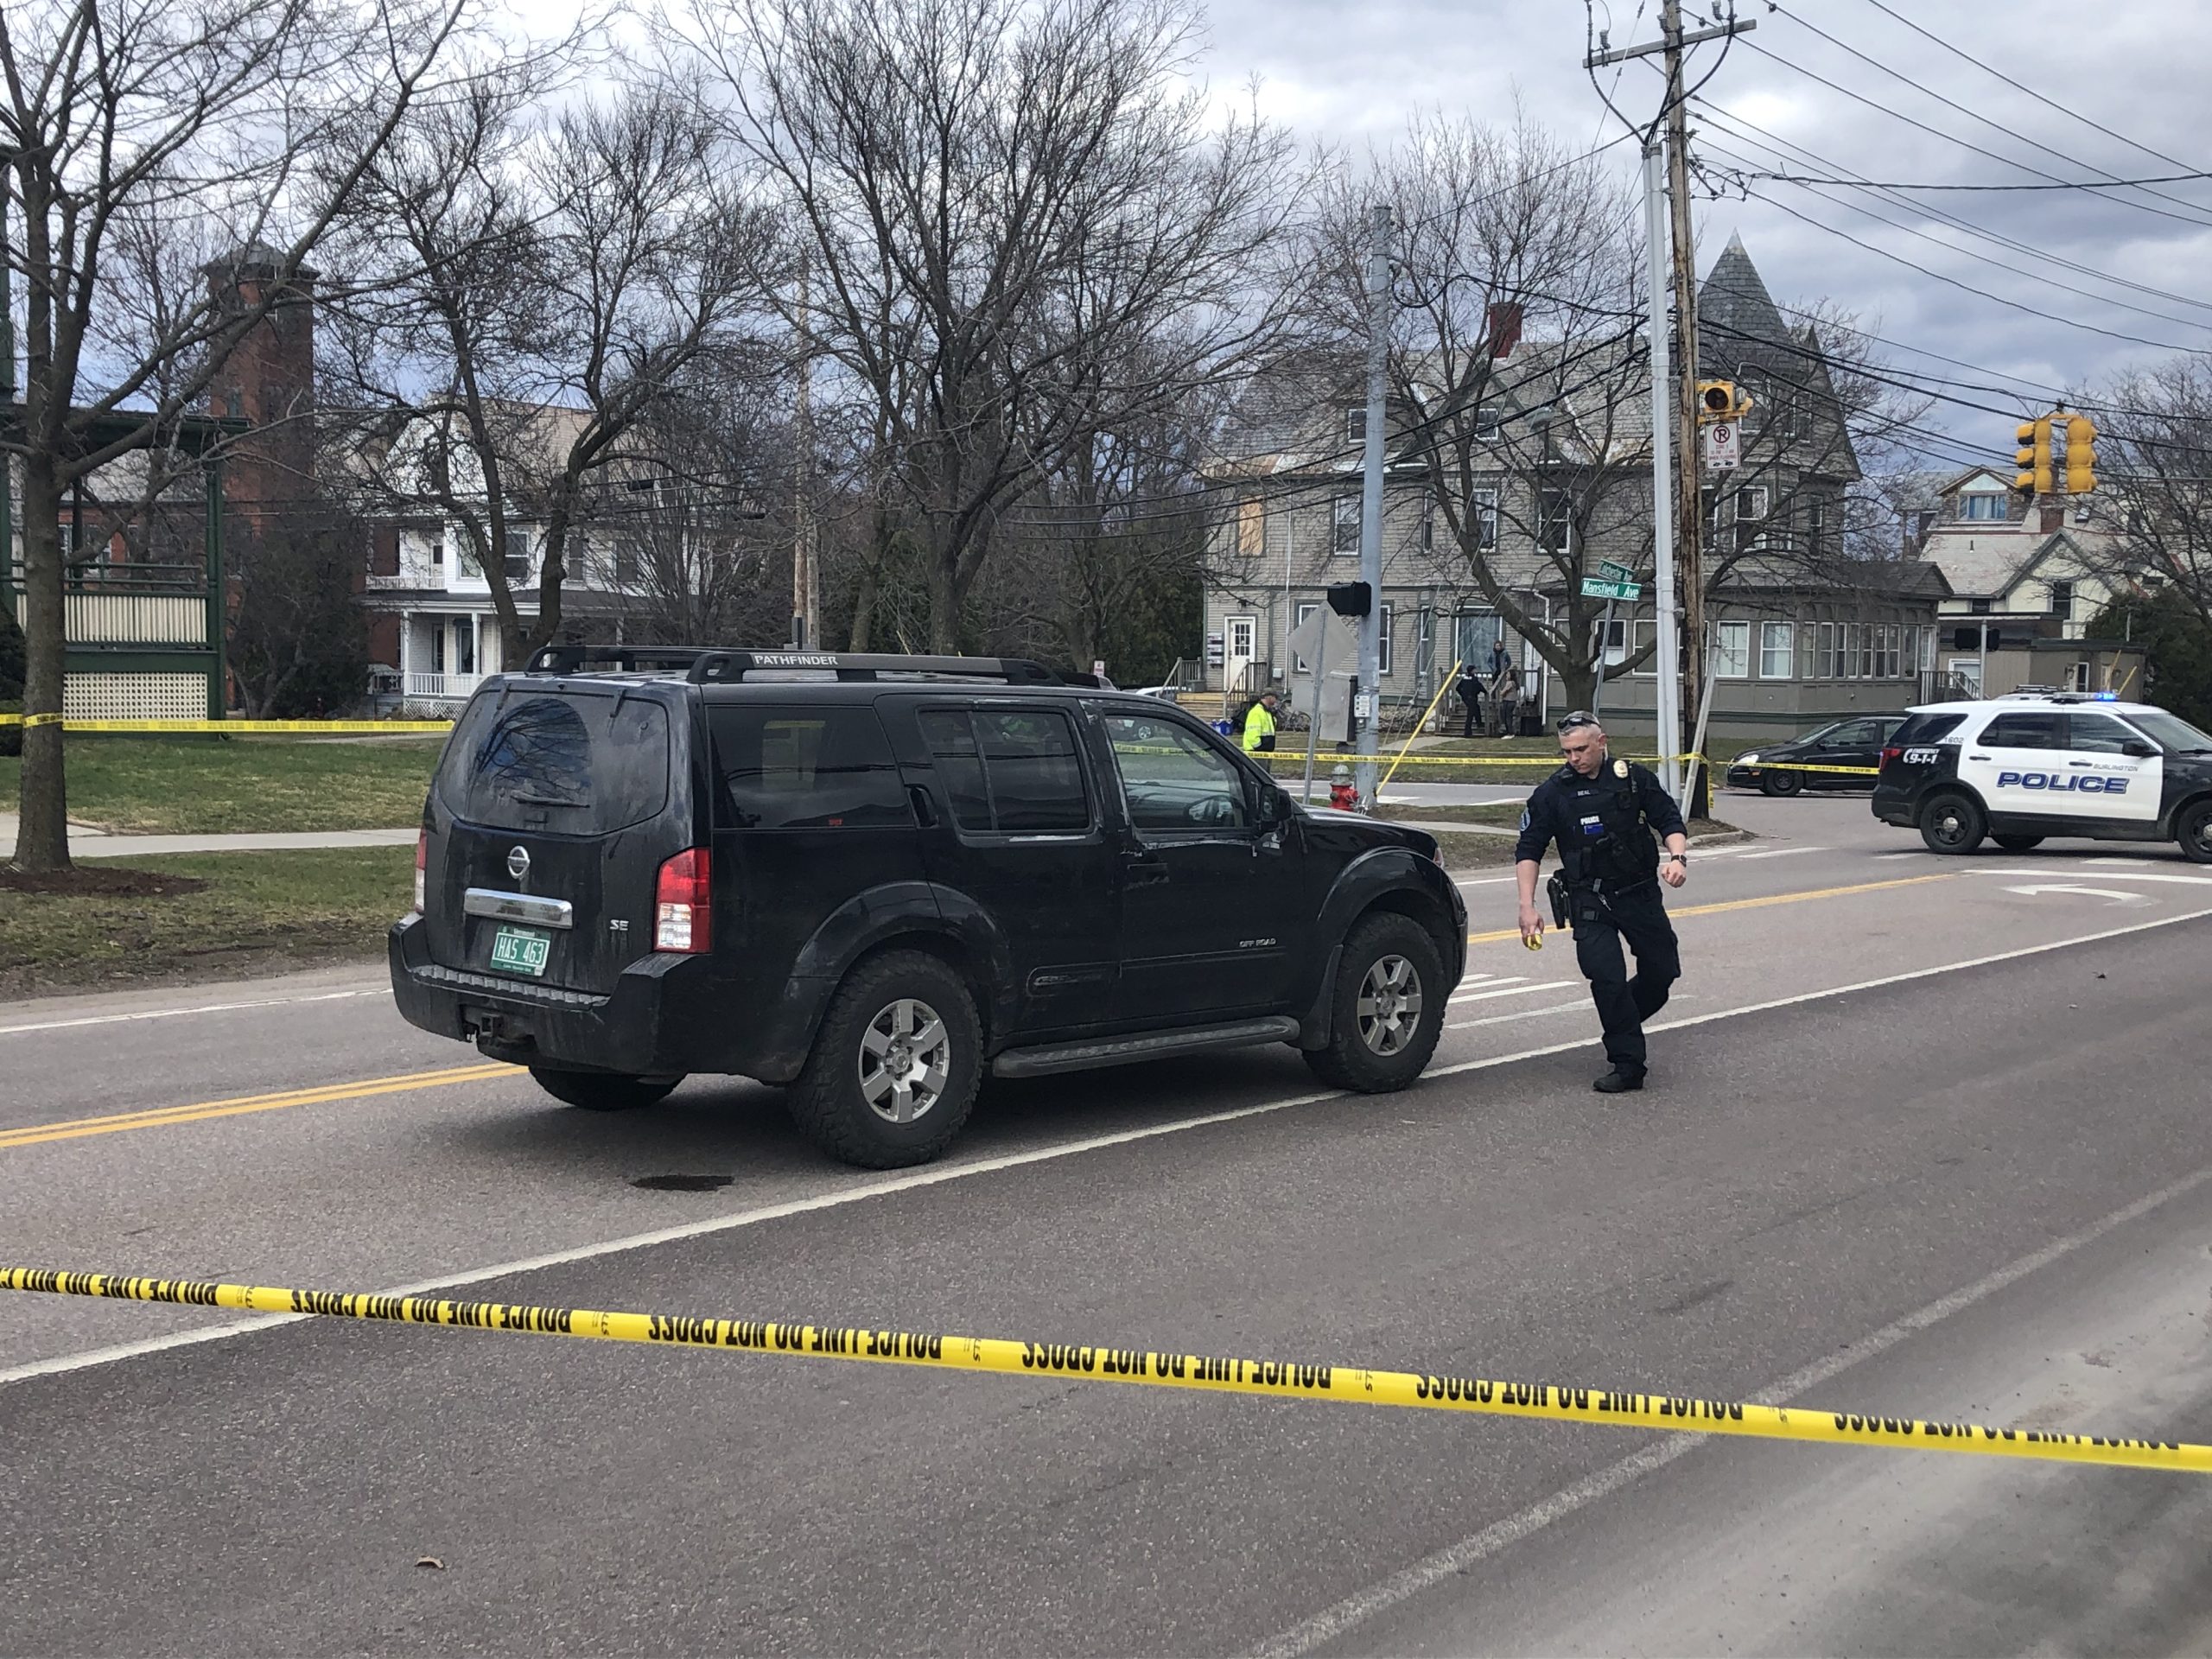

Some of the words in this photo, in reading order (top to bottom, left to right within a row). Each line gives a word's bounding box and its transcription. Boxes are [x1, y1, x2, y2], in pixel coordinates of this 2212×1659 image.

[1582, 581, 1619, 596] Mansfield
[1623, 586, 1639, 598] Ave
[754, 655, 838, 665] PATHFINDER
[2093, 763, 2139, 772] BURLINGTON
[1997, 772, 2130, 794] POLICE
[1580, 815, 1599, 825] POLICE
[609, 919, 629, 931] SE
[497, 937, 519, 960] HAS
[523, 941, 544, 963] 463
